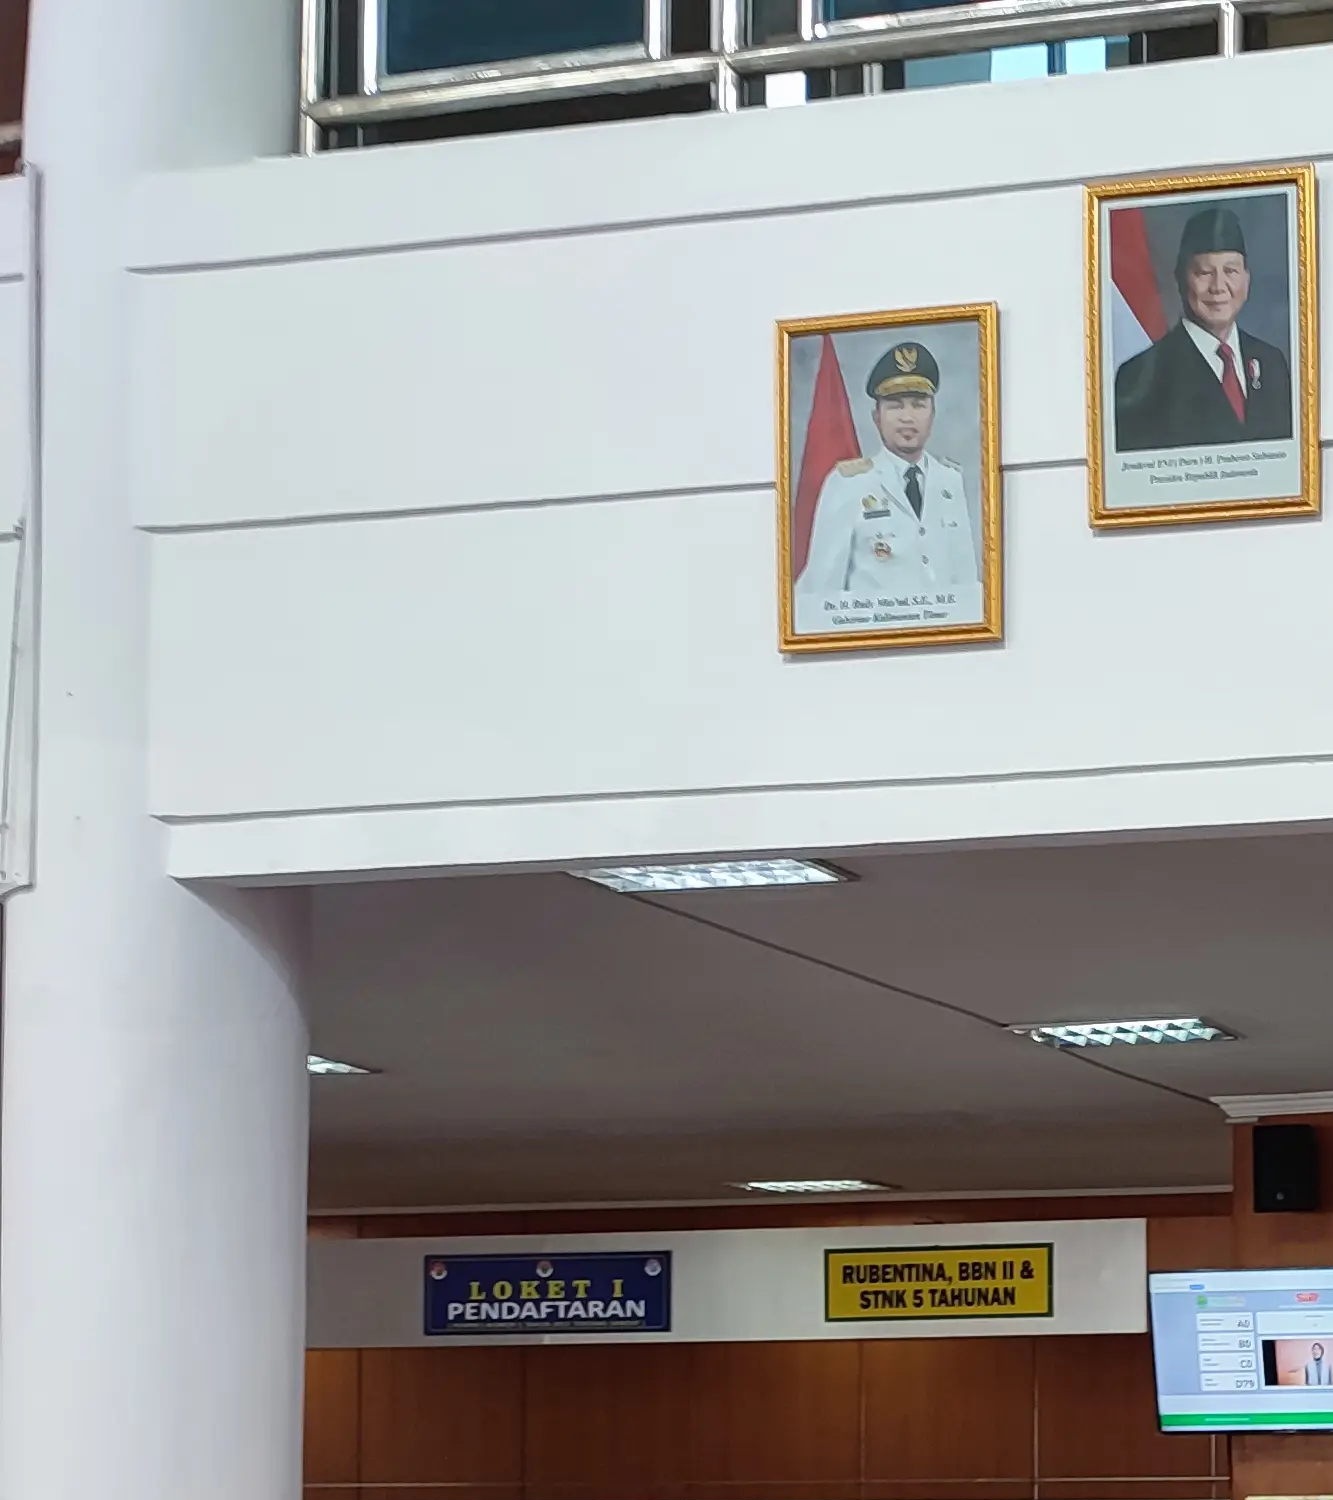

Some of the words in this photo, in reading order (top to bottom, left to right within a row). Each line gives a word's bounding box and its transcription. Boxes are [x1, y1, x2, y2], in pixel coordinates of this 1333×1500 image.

[842, 1261, 953, 1286] RUBENTINA,
[958, 1260, 997, 1282] BBN
[1002, 1260, 1015, 1281] II
[1019, 1259, 1035, 1280] &
[468, 1279, 592, 1300] LOKET
[611, 1278, 625, 1298] I
[859, 1288, 907, 1310] STNK
[912, 1288, 924, 1308] 5
[928, 1285, 1016, 1308] TAHUNAN
[446, 1298, 647, 1321] PENDAFTARAN
